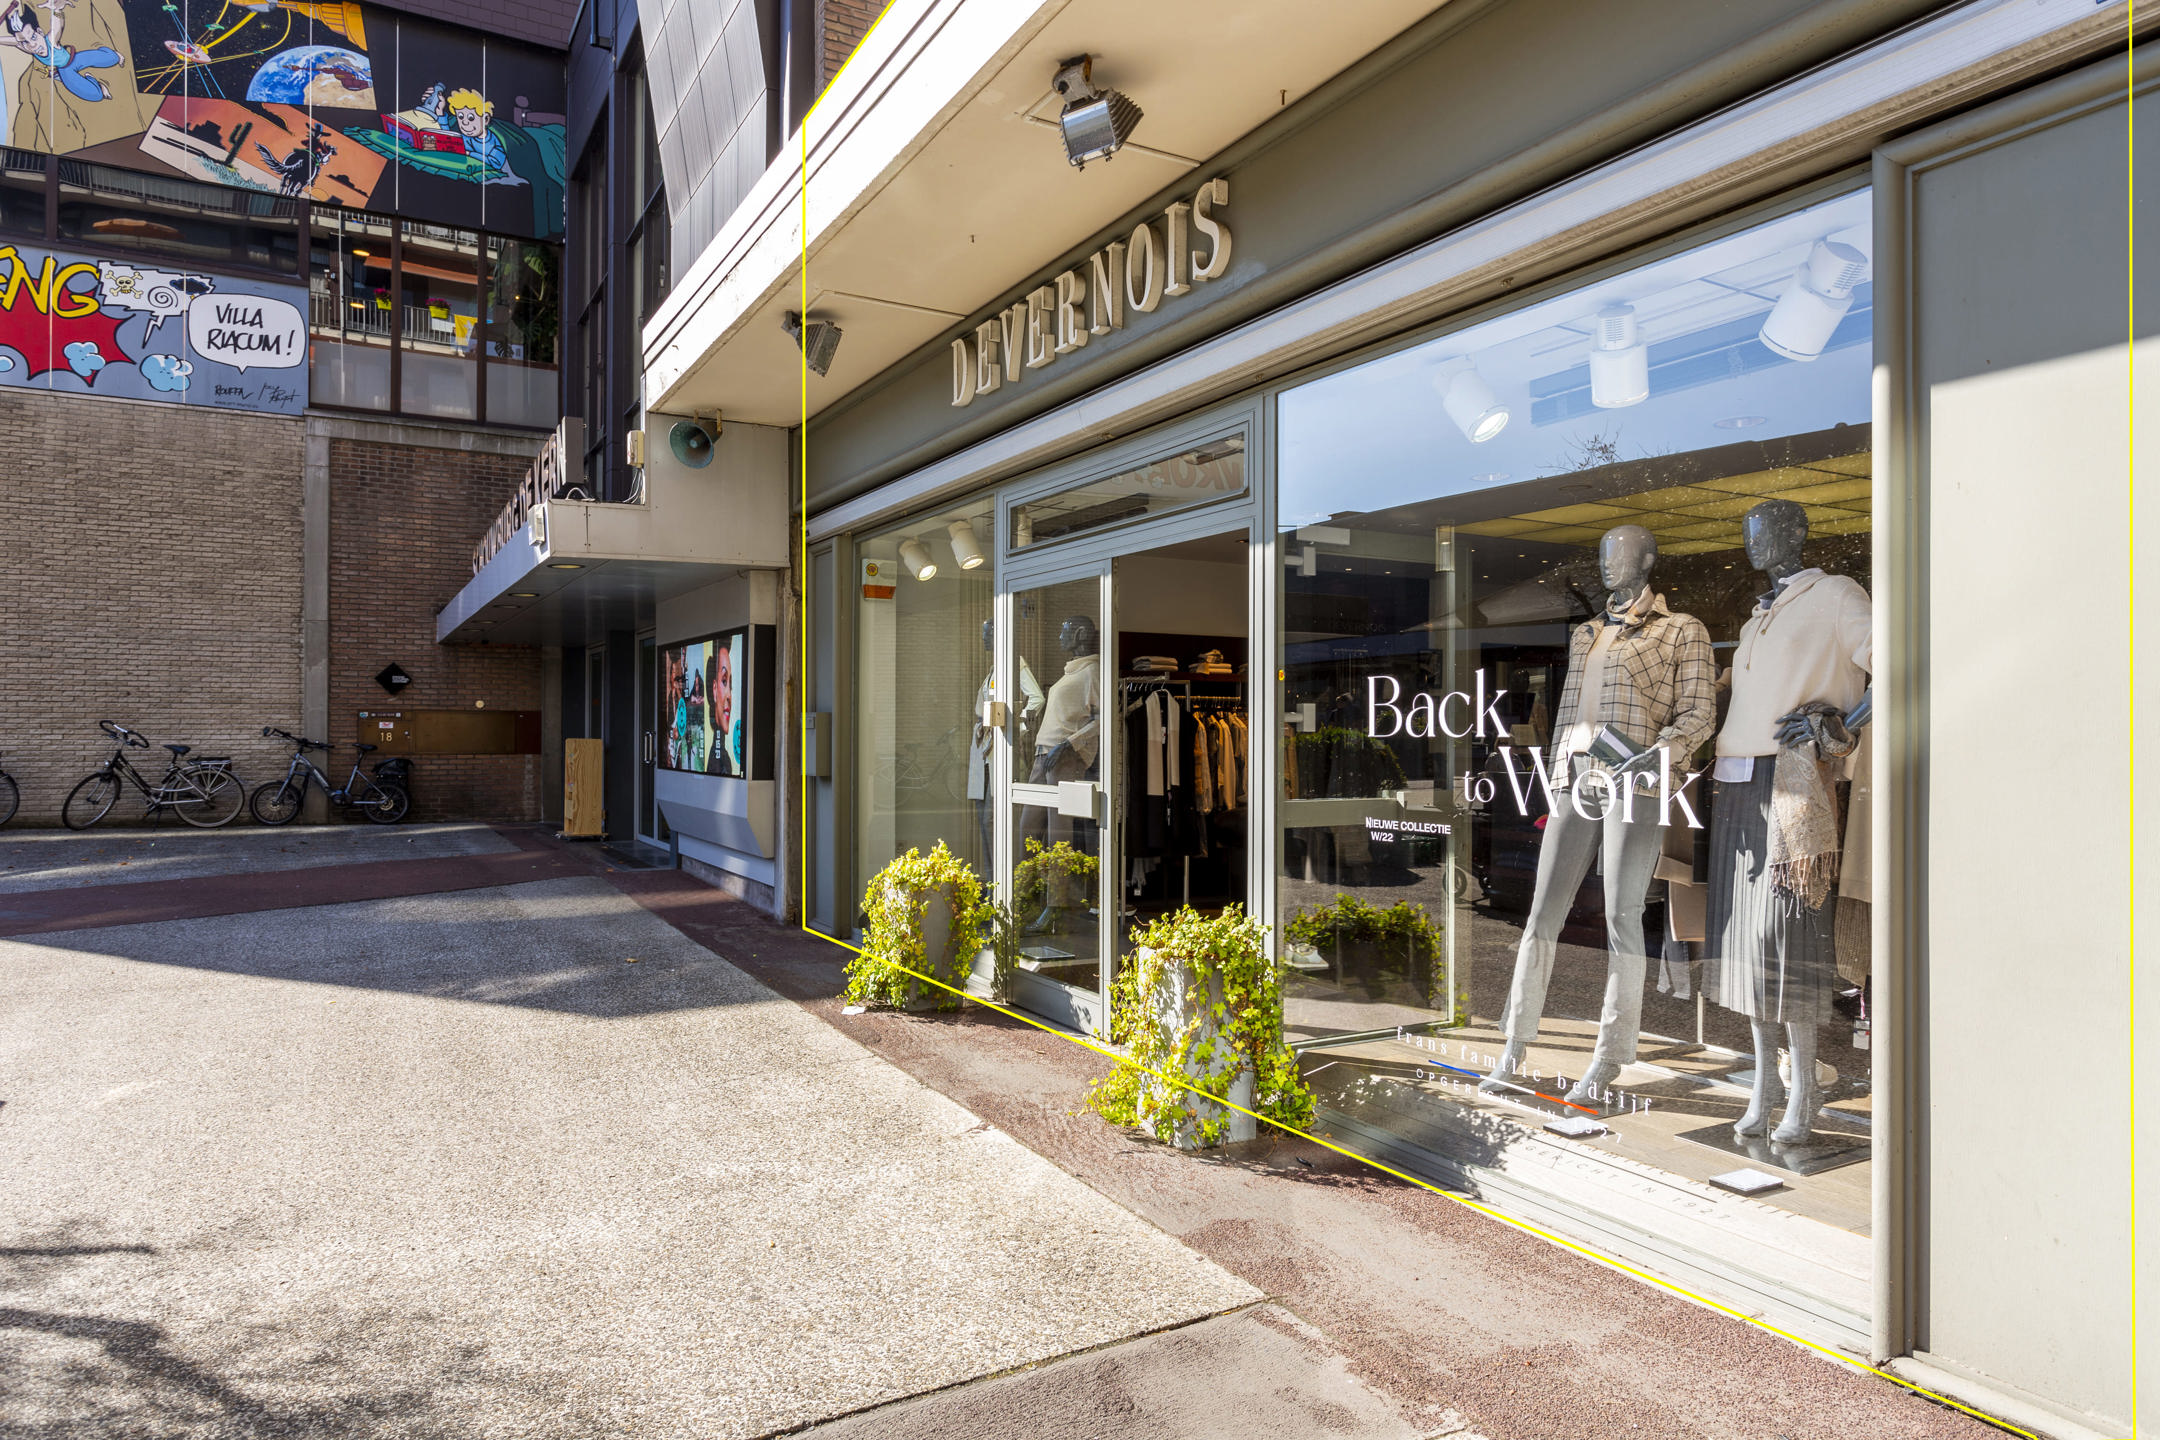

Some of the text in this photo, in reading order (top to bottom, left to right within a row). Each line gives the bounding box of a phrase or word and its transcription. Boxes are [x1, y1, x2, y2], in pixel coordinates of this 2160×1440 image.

[0, 245, 101, 319] NG
[215, 303, 264, 328] VILLA
[952, 178, 1231, 406] DEVERNOIS
[379, 731, 393, 743] 18
[1367, 668, 1510, 738] Back
[1463, 746, 1704, 829] to Work
[1365, 816, 1452, 835] NIEUWE COLLECTIE
[1370, 831, 1394, 842] W/22
[1396, 1025, 1653, 1117] frans familie bedrijf
